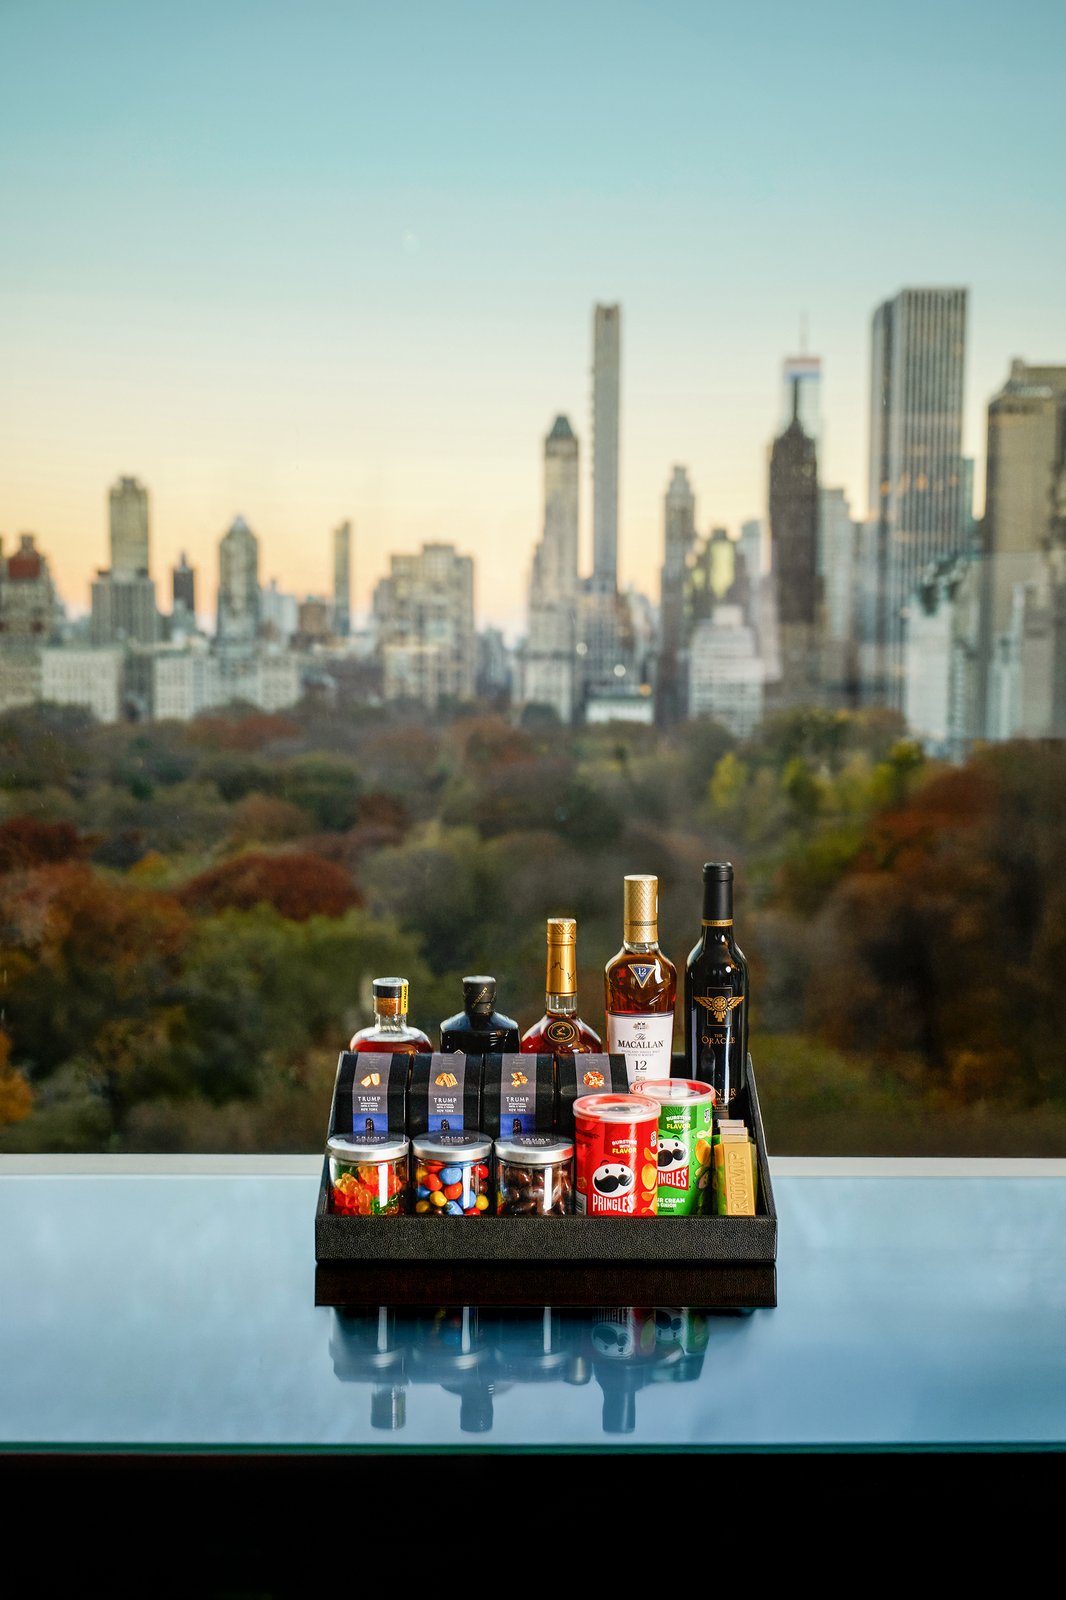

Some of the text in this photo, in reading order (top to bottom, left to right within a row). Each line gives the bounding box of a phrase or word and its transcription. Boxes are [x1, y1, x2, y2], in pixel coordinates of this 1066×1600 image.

[618, 1040, 664, 1048] MACALLAN
[702, 1036, 735, 1044] ORACLE
[634, 1061, 647, 1070] 12
[658, 1169, 687, 1187] INGLES
[728, 1151, 748, 1214] RUMP
[593, 1194, 634, 1214] PRINGLES
